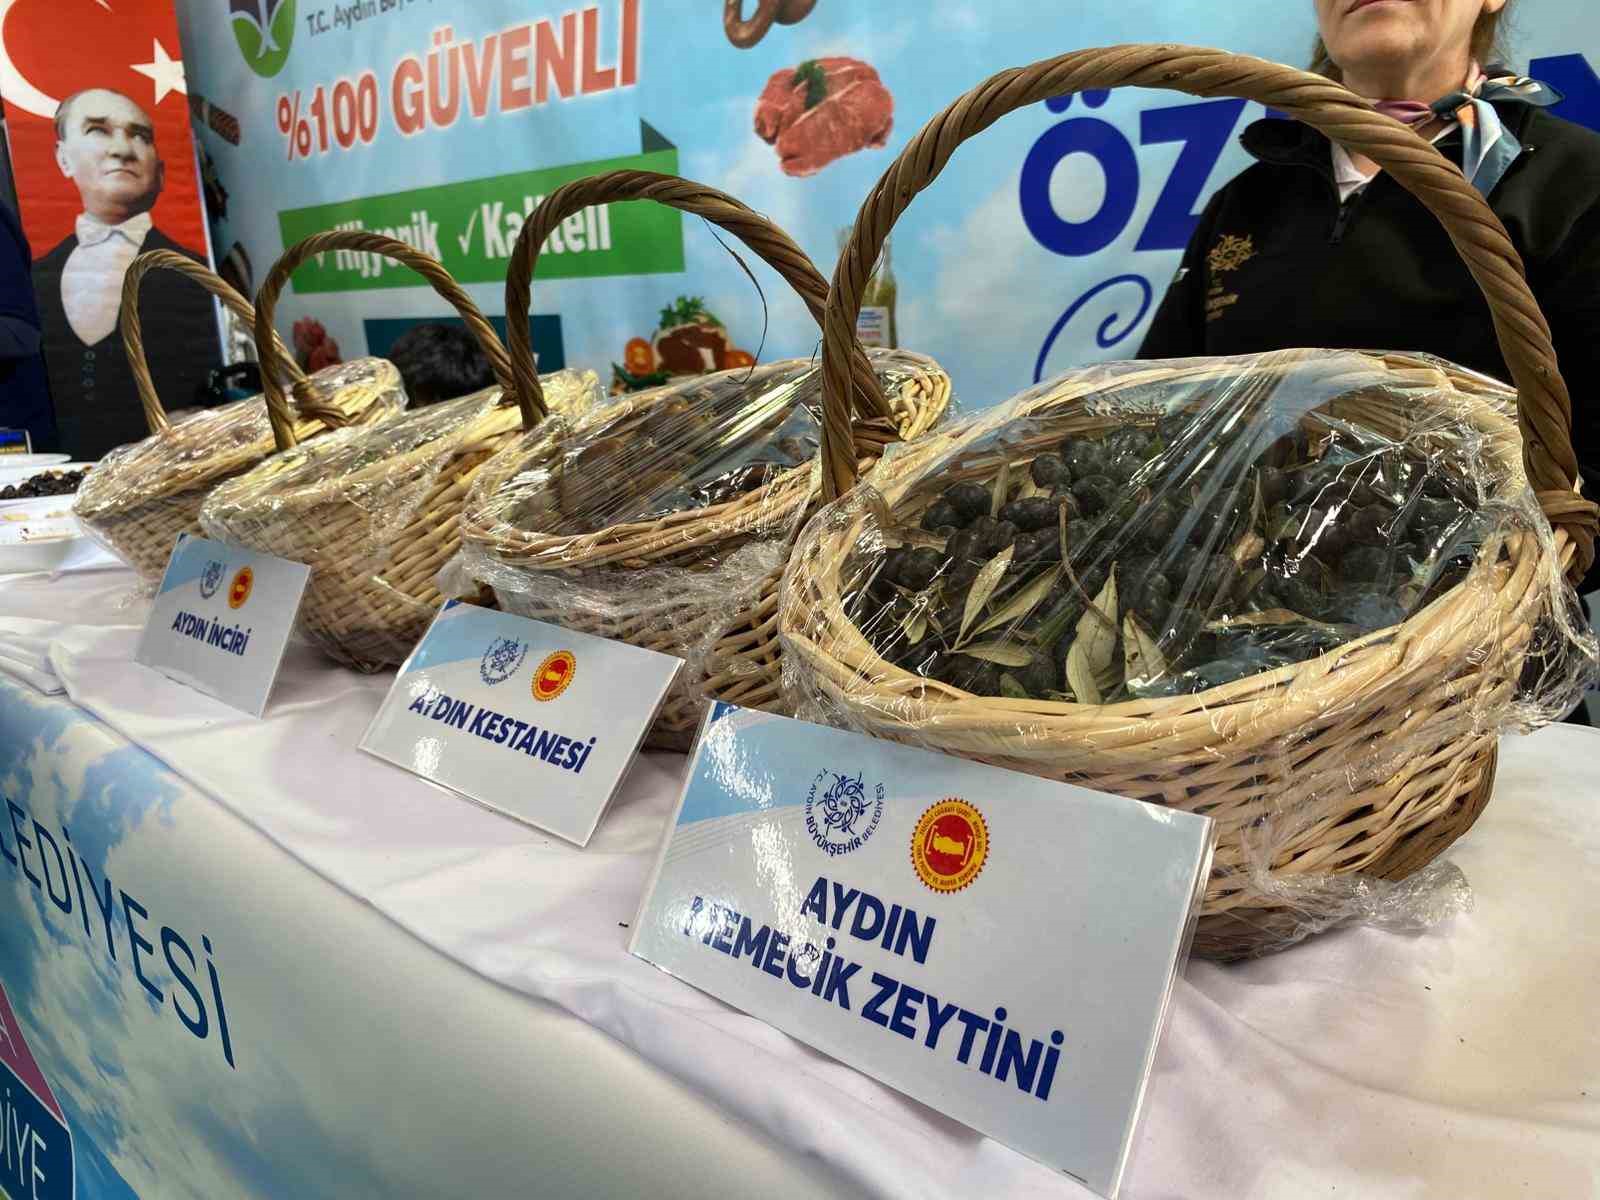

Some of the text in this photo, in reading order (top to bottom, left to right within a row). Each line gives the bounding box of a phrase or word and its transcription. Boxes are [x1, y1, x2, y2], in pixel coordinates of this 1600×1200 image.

[277, 73, 378, 160] %100
[1019, 87, 1290, 257] ÖZ
[171, 611, 252, 656] AYDIN İNCİRİ
[408, 687, 597, 774] AYDIN KESTANESİ
[799, 876, 936, 965] AYDIN
[861, 971, 1065, 1101] ZEYTİNİ
[0, 1087, 47, 1200] İYE
